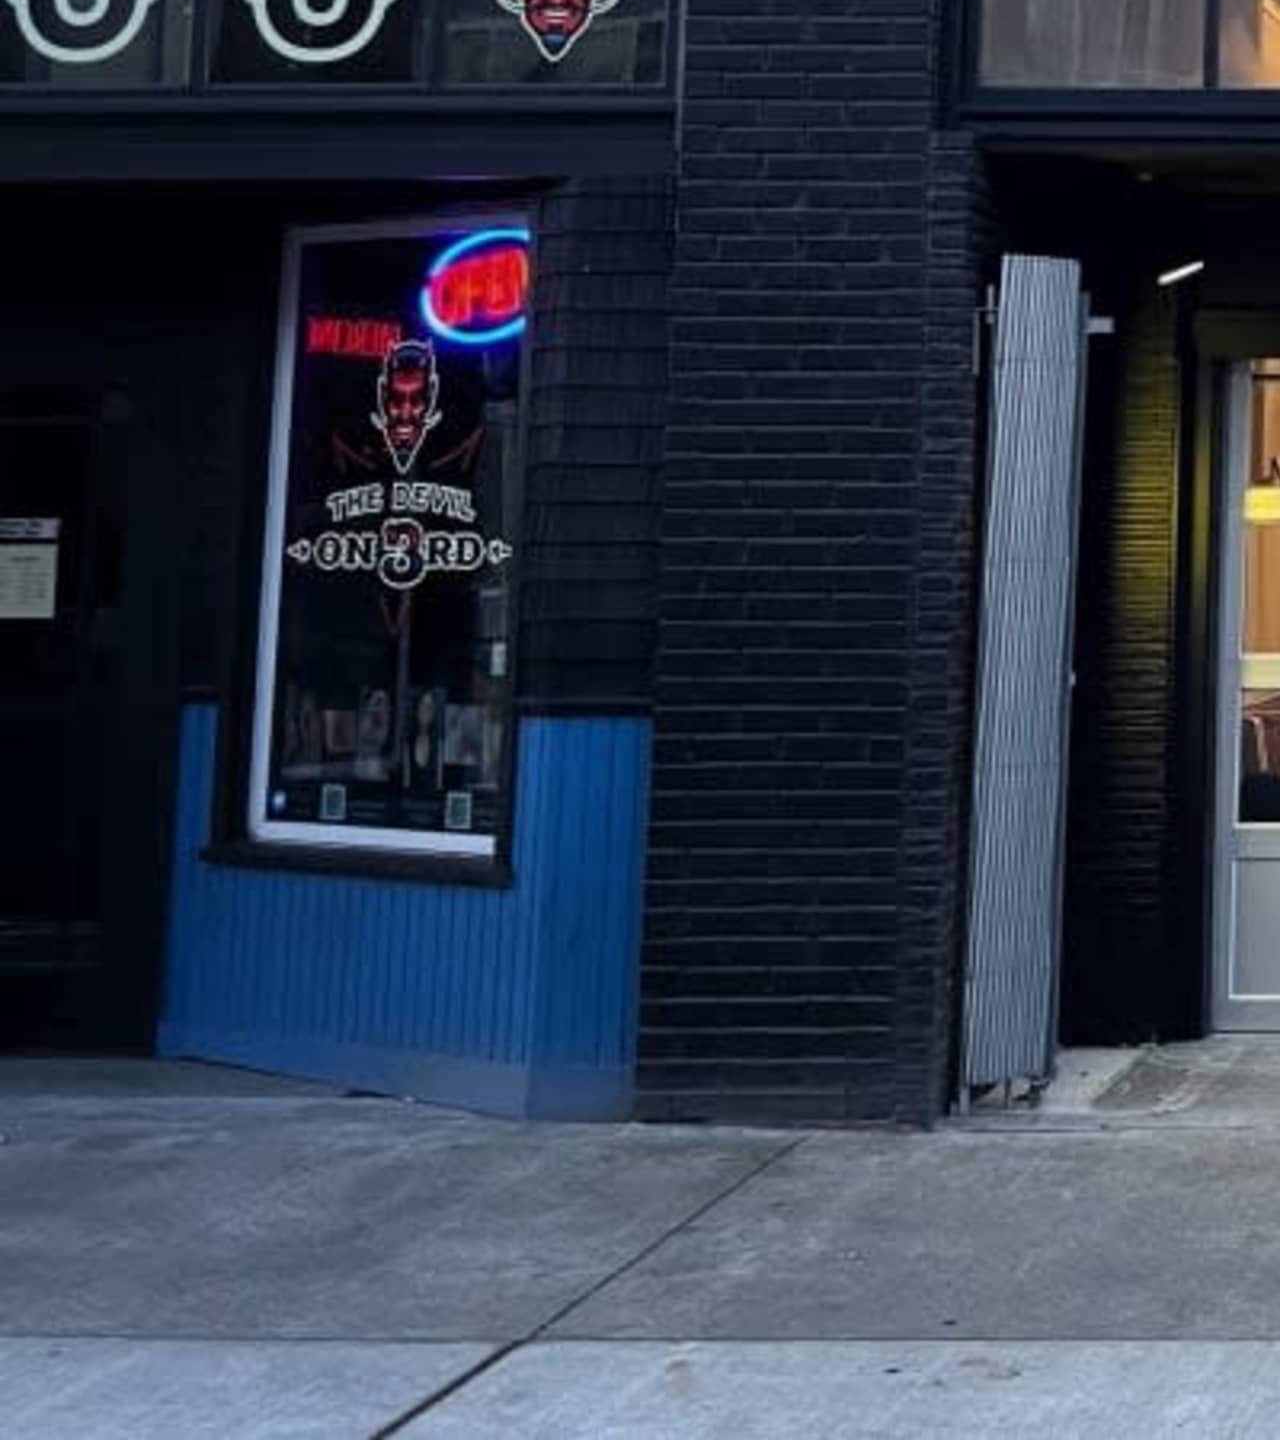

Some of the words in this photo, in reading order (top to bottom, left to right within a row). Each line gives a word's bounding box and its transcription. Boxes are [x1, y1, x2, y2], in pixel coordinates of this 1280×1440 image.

[326, 481, 384, 523] THE
[391, 481, 477, 523] DEVIL
[314, 531, 379, 571] ON
